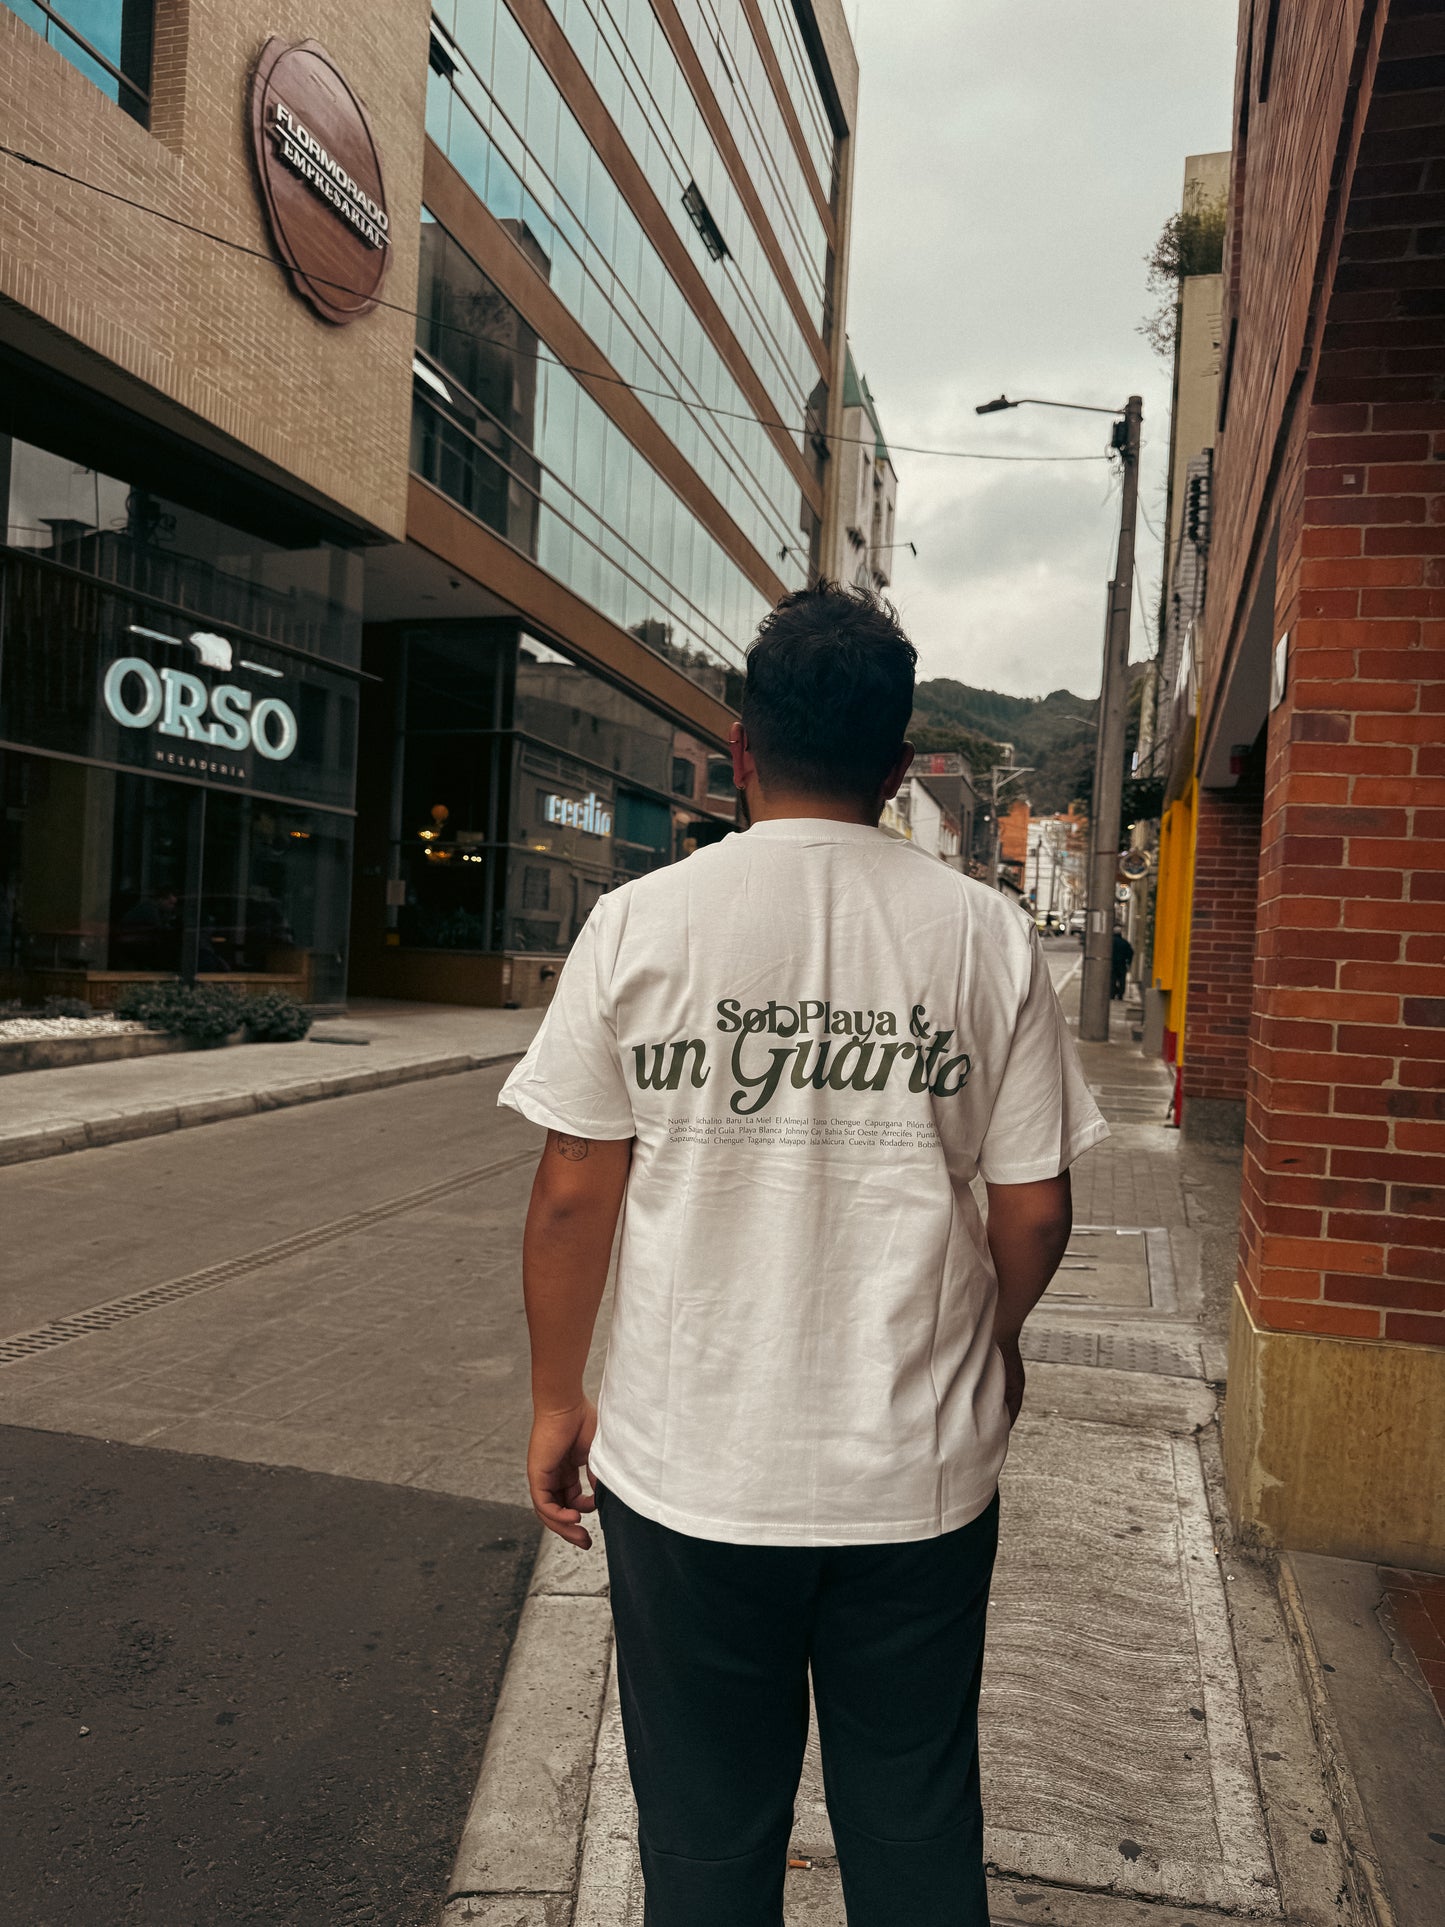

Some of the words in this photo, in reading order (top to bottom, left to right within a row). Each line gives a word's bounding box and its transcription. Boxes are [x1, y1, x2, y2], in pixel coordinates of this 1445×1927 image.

[276, 103, 389, 231] FLORMORADO
[284, 138, 384, 249] EMPRESARIAL
[104, 657, 297, 760] ORSO
[798, 1000, 898, 1043] Playa
[909, 1004, 931, 1040] &
[631, 1038, 711, 1091] un
[758, 1127, 782, 1135] Blanca
